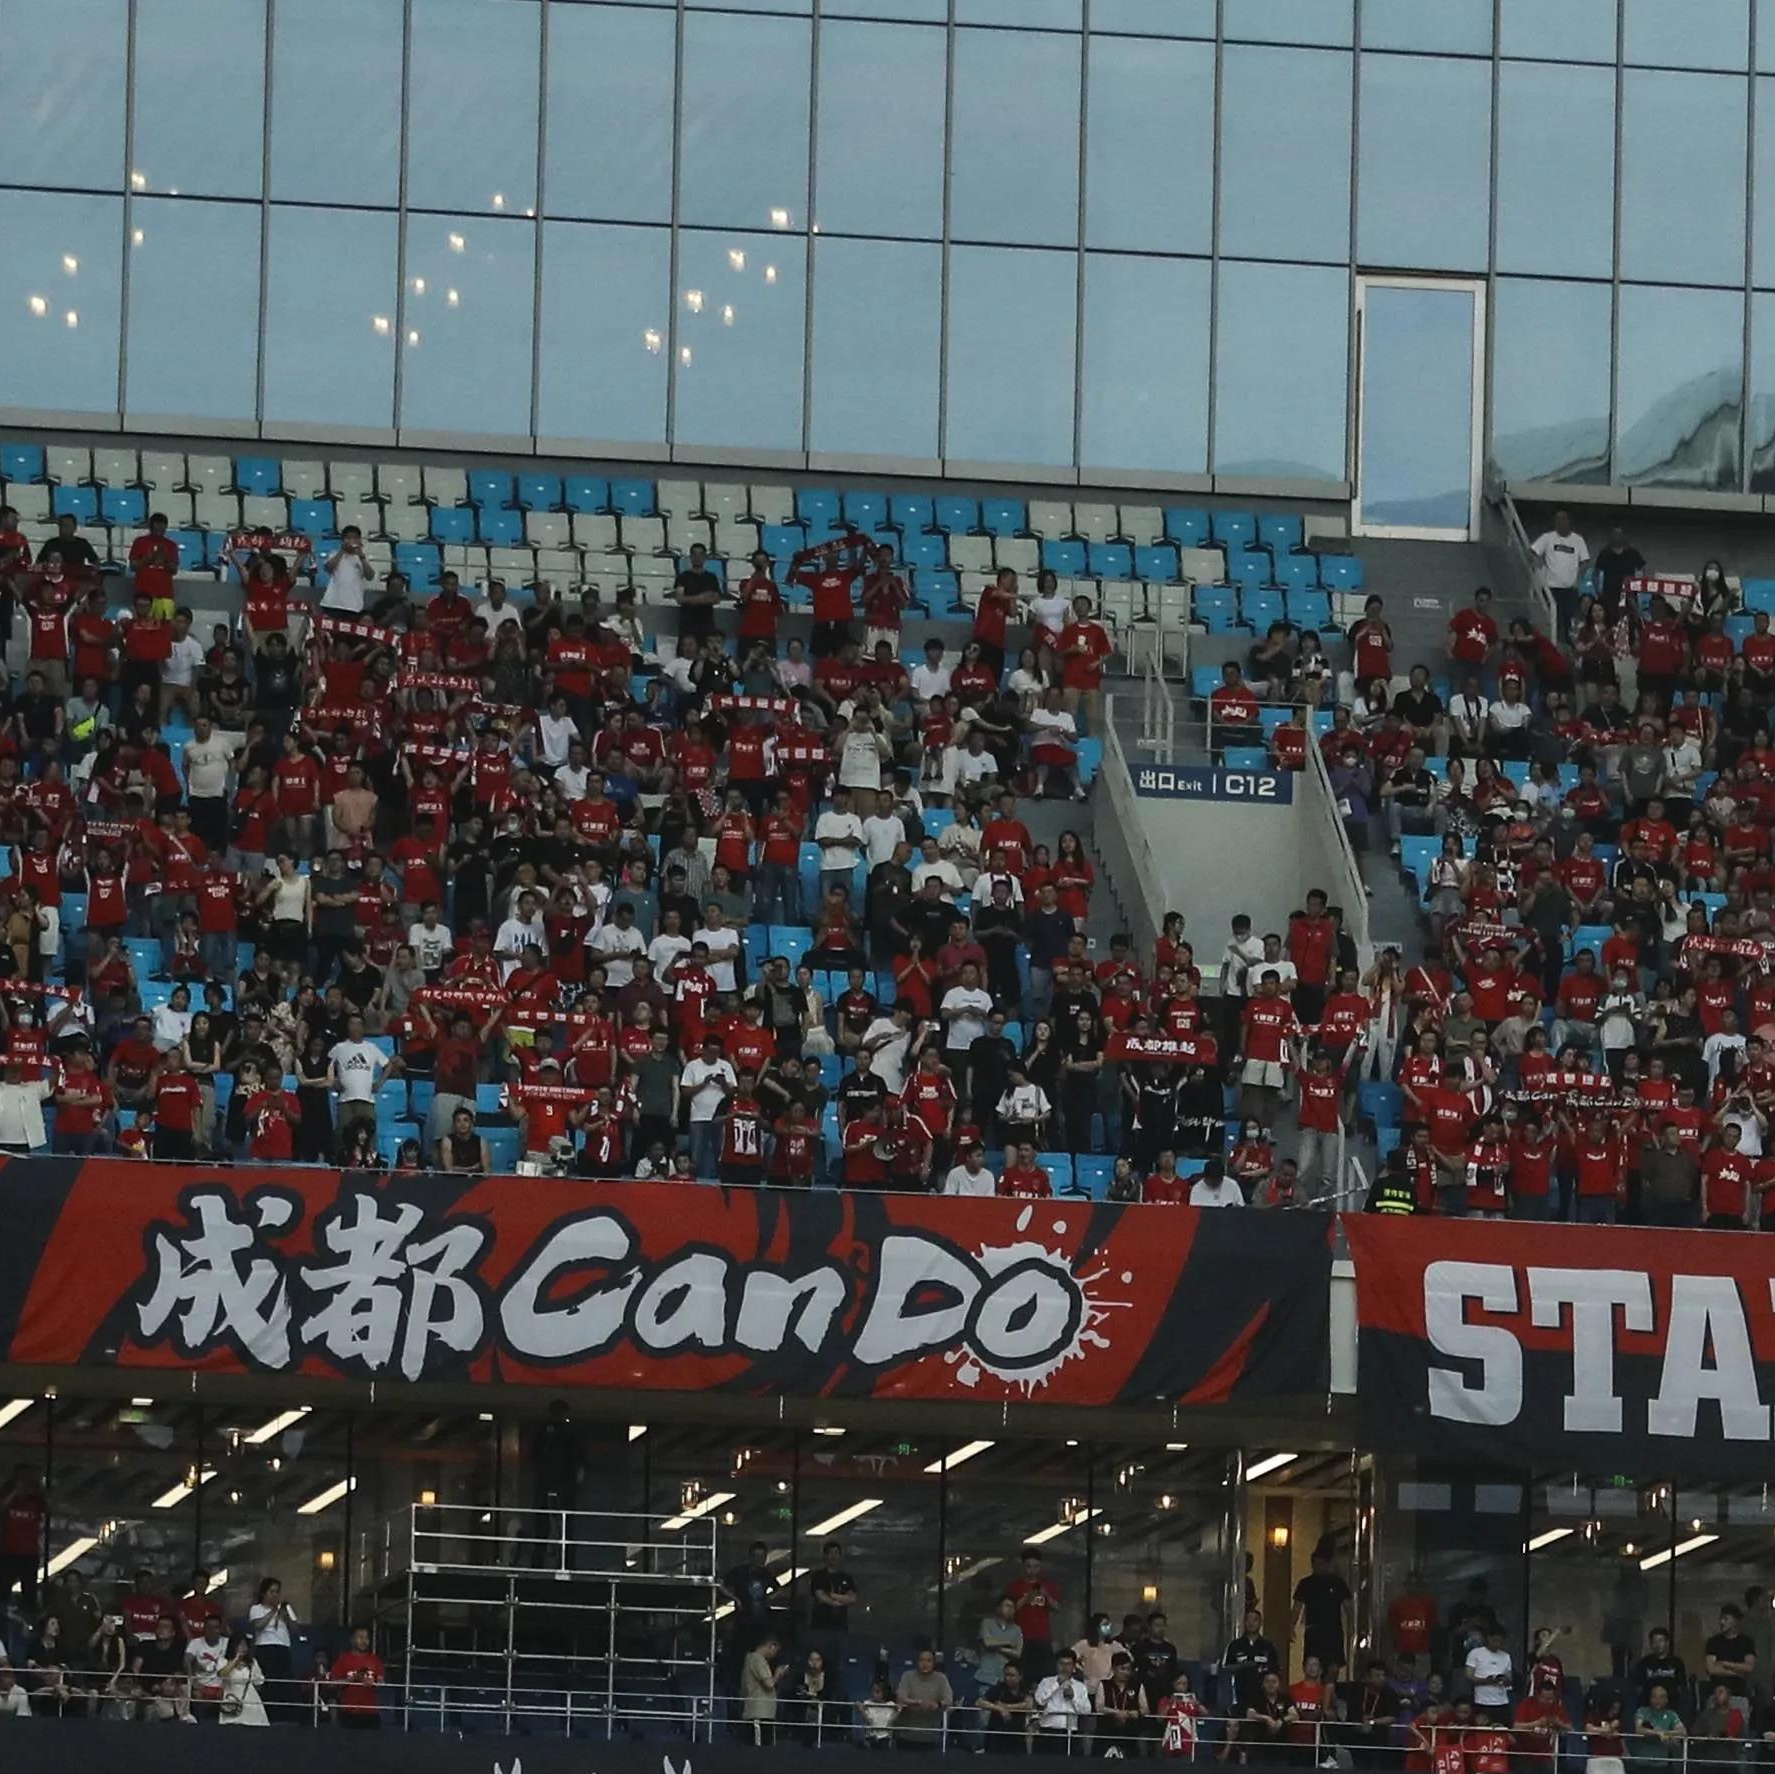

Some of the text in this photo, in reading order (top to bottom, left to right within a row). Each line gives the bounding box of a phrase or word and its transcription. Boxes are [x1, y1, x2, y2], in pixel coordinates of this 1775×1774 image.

[1139, 770, 1275, 796] 出口 Exit C12
[137, 1192, 484, 1382] 成都
